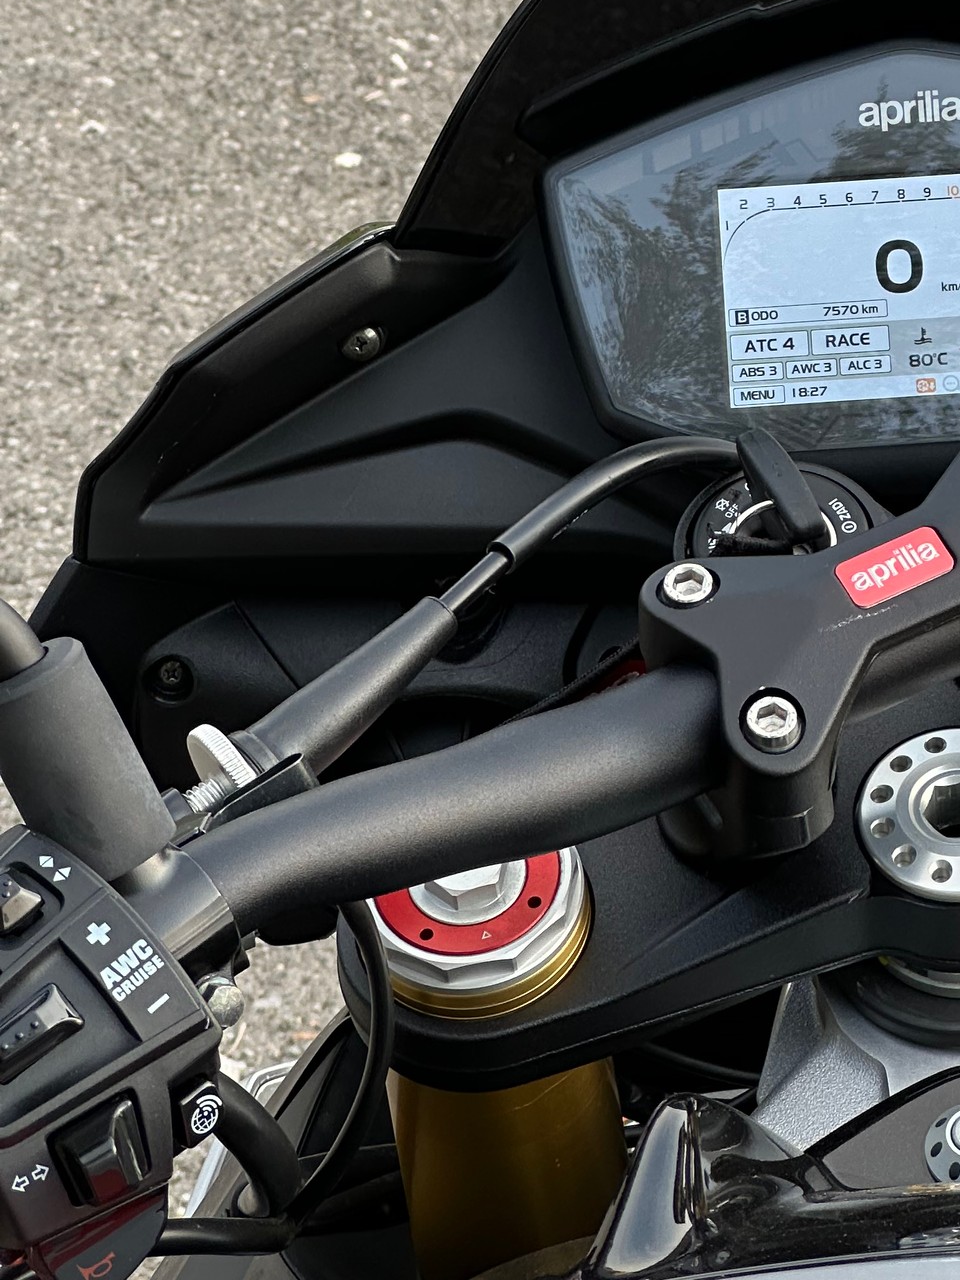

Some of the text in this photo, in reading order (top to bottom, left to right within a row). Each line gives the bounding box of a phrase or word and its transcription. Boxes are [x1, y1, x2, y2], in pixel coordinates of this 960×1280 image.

[739, 199, 748, 210] 2
[766, 197, 775, 208] 3
[793, 195, 802, 206] 4
[819, 194, 827, 204] 5
[845, 192, 853, 203] 6
[871, 190, 879, 201] 7
[897, 189, 905, 199] 8
[923, 187, 931, 197] 9
[947, 185, 960, 196] 10
[875, 239, 924, 294] 0
[736, 304, 879, 323] B ODO 7570 km
[744, 337, 795, 353] ATC 4
[825, 332, 871, 348] RACE
[848, 359, 882, 371] ALC 3
[909, 352, 948, 368] 80°C
[739, 365, 777, 378] ABS 3
[791, 362, 832, 375] AWC 3
[740, 386, 828, 401] MENU 18:27
[724, 503, 740, 519] OFF
[828, 497, 852, 522] ZADI
[850, 542, 940, 591] aprilia
[100, 939, 154, 990] AWC
[111, 954, 165, 1002] CRUISE
